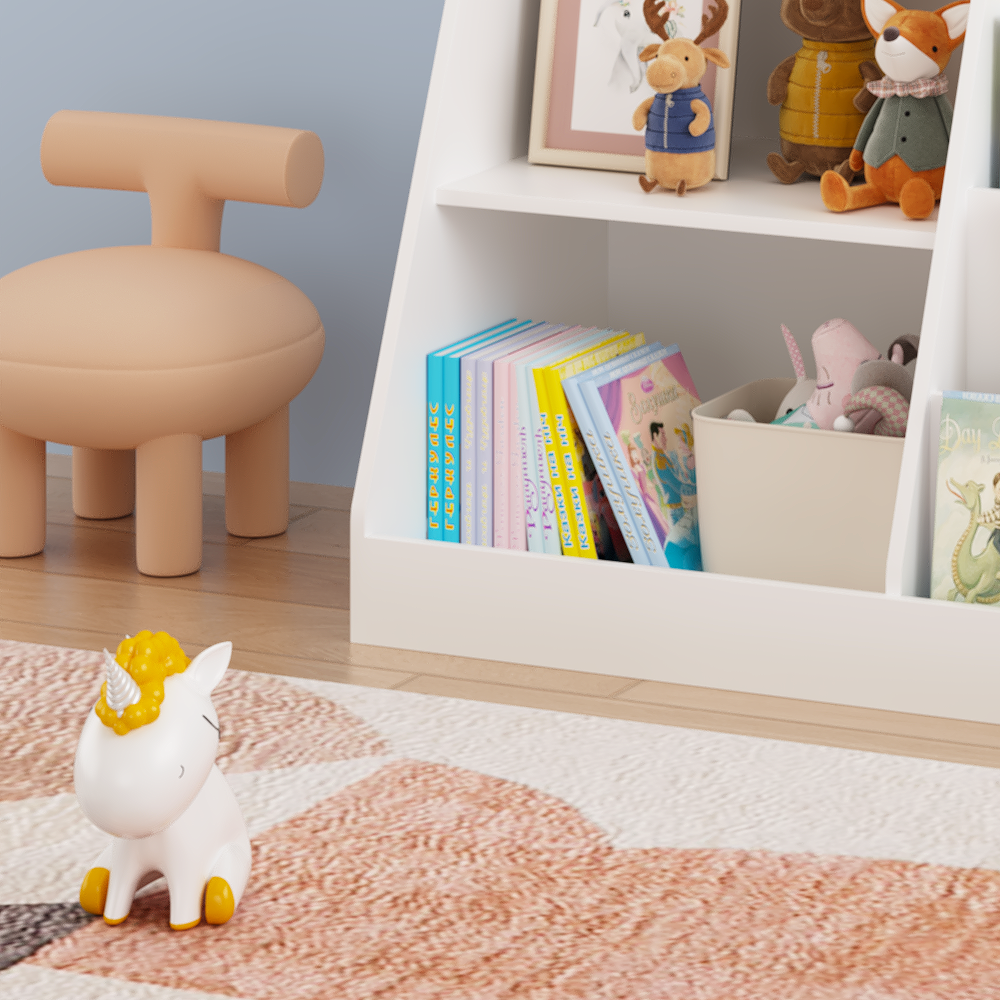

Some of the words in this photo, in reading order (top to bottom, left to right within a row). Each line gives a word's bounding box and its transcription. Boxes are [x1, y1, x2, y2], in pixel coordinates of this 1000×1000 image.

[539, 412, 553, 445] ніч
[555, 413, 569, 446] ніч
[938, 413, 981, 455] Day
[547, 451, 560, 479] на
[563, 453, 576, 480] на
[553, 485, 573, 548] Казки
[570, 487, 589, 550] Казки
